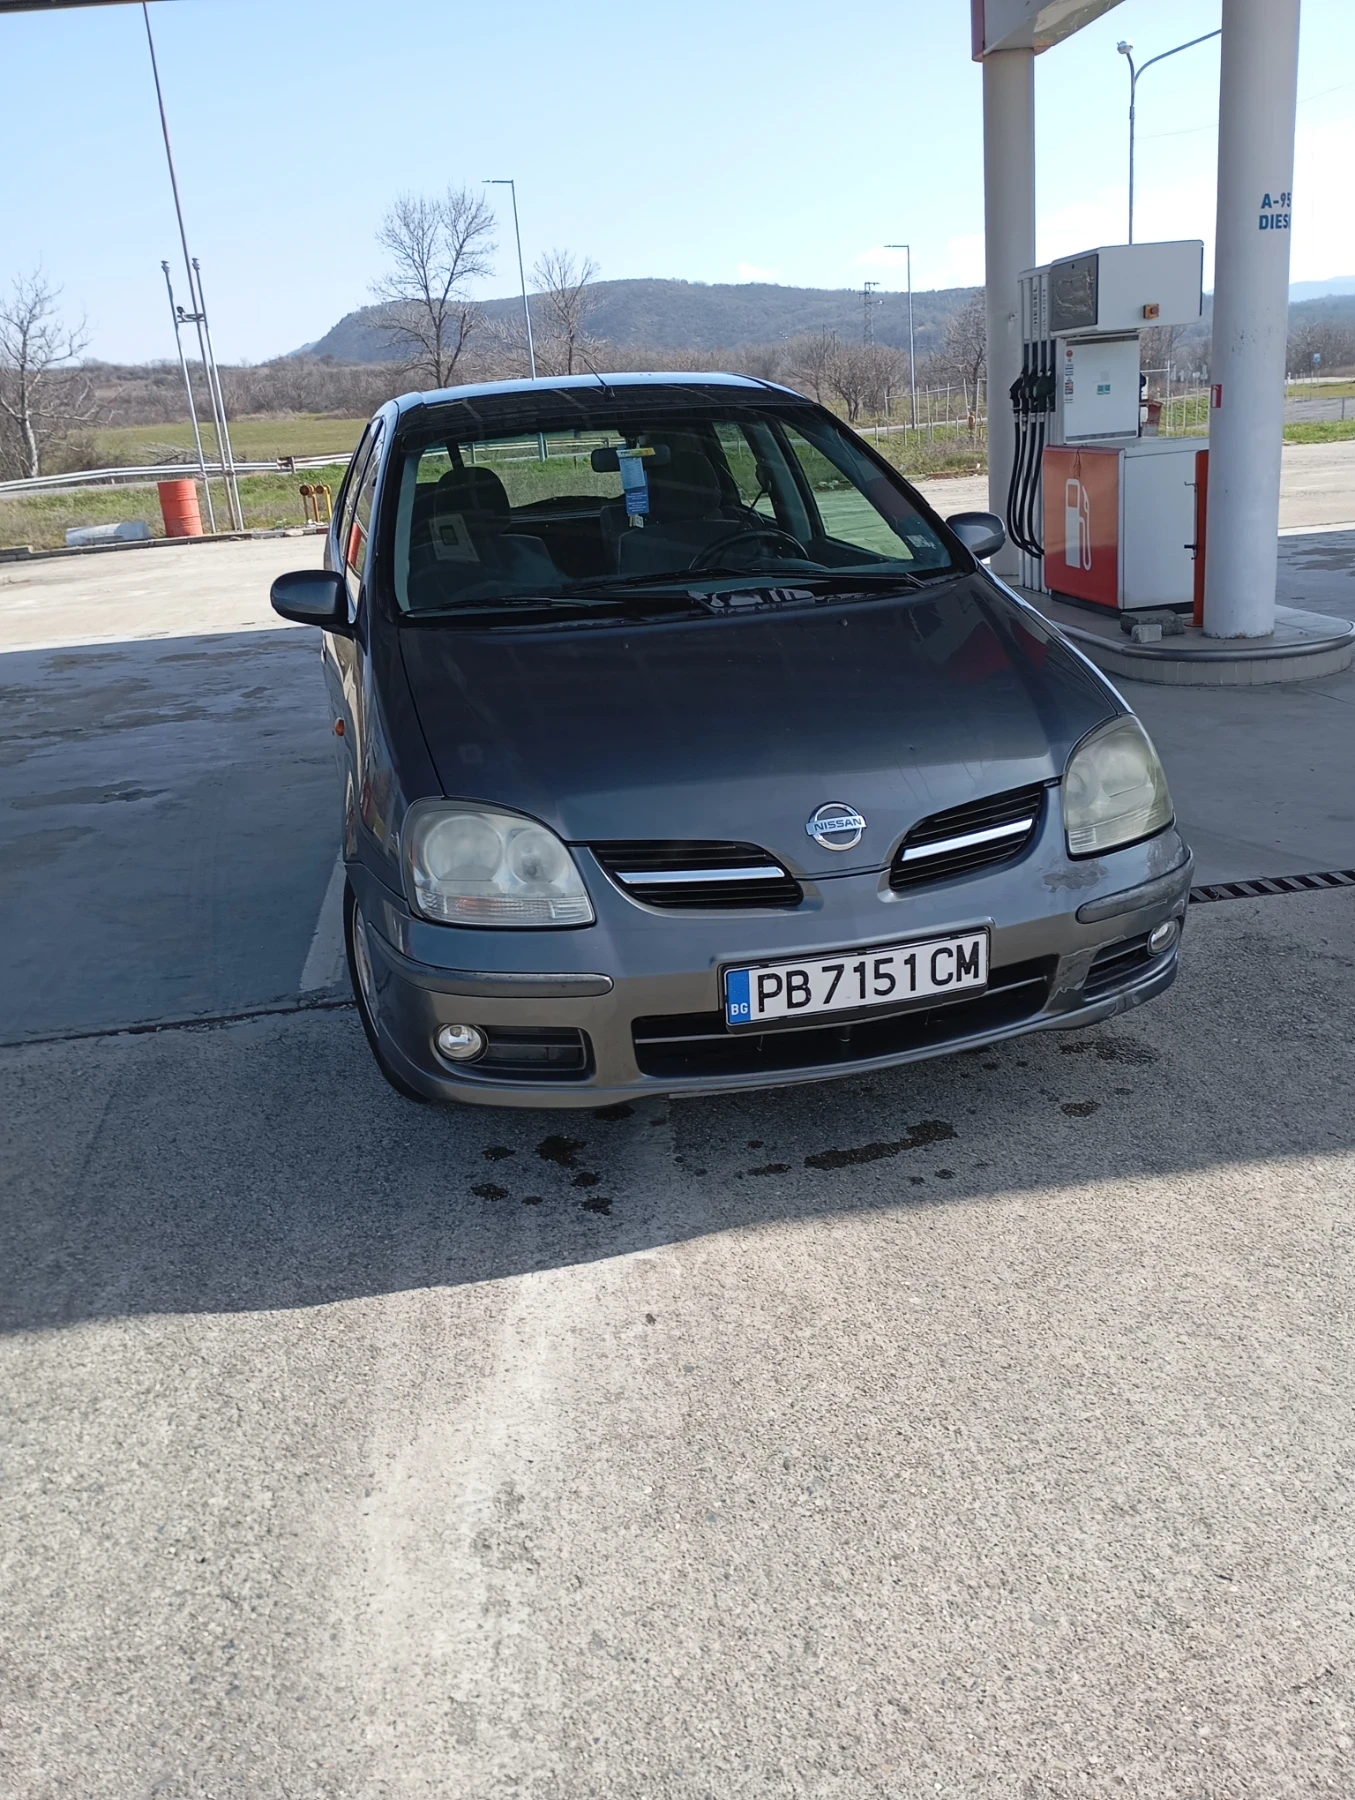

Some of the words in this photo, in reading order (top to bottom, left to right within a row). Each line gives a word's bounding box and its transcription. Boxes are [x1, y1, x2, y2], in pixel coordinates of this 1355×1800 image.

[1261, 192, 1291, 209] A-95
[1259, 213, 1291, 230] DIES
[814, 818, 862, 831] NISSAN
[731, 1002, 749, 1015] BG
